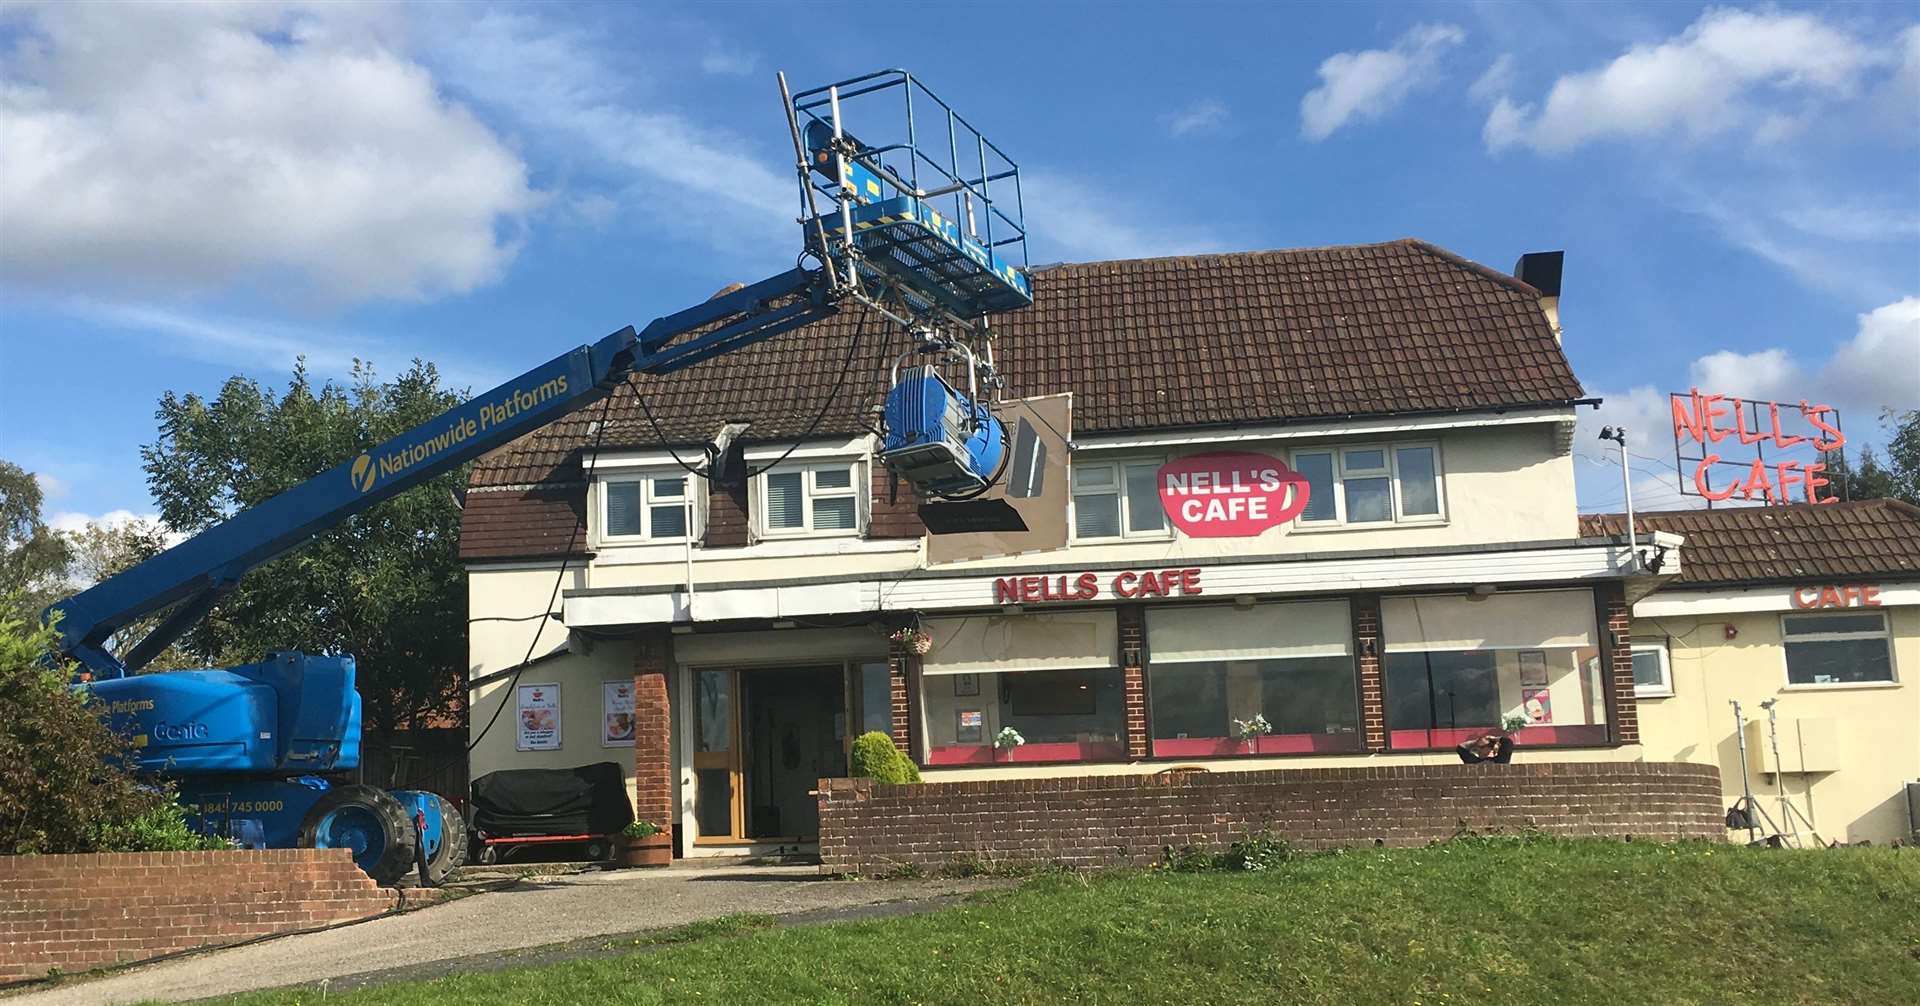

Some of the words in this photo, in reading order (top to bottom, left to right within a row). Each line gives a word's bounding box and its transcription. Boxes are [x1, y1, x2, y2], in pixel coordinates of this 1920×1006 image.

[379, 417, 477, 479] Nationwide
[479, 374, 569, 430] Platforms
[1672, 386, 1845, 452] NELL'S
[1165, 468, 1280, 498] NELL'S
[1695, 454, 1840, 507] CAFE
[1181, 497, 1268, 523] CAFE
[996, 573, 1099, 604] NELLS
[1115, 569, 1202, 598] CAFE
[1793, 584, 1881, 609] CAFE
[112, 698, 154, 713] Platforms
[154, 721, 207, 740] Genie
[231, 801, 253, 813] 745
[255, 800, 284, 812] 0000
